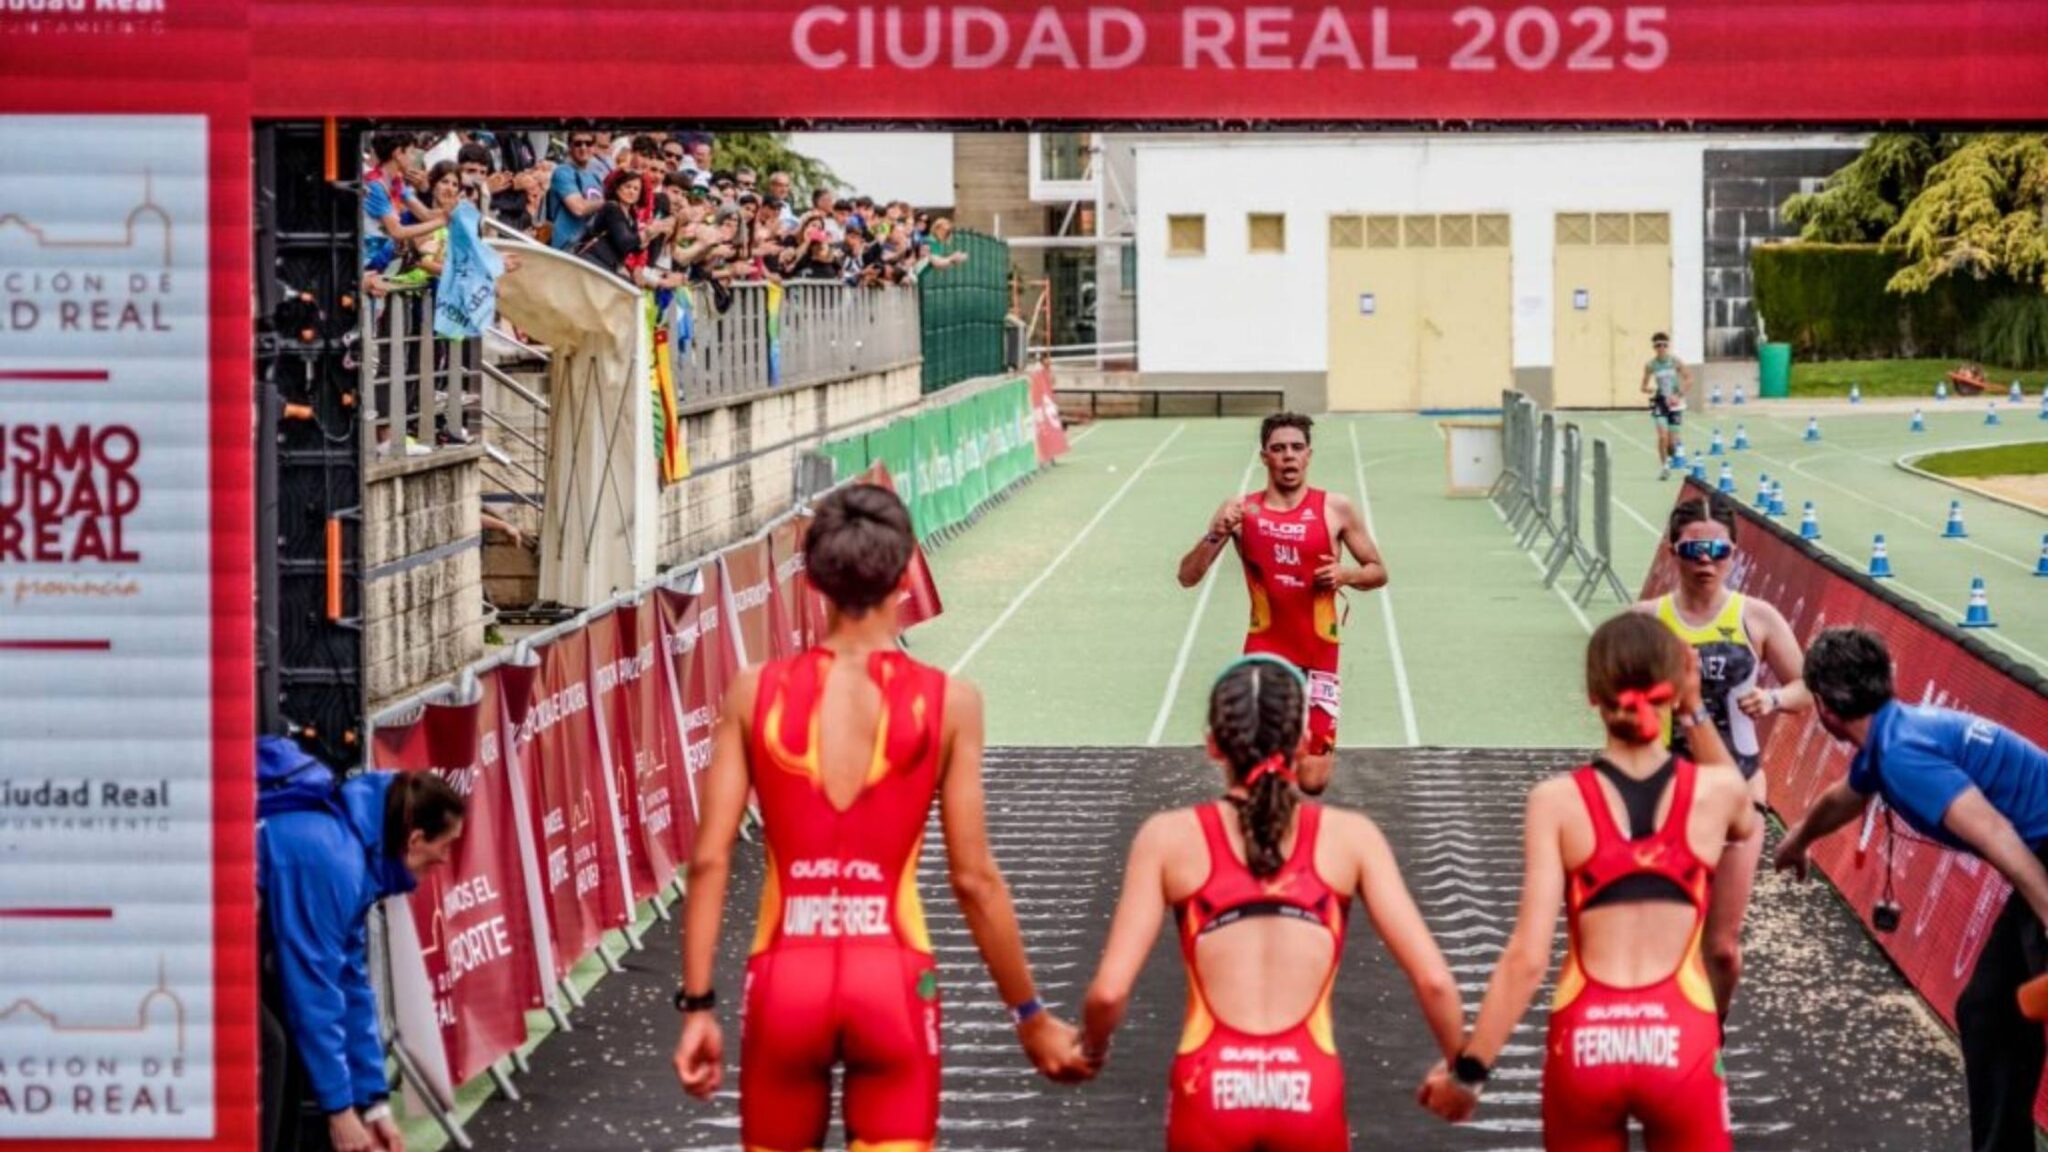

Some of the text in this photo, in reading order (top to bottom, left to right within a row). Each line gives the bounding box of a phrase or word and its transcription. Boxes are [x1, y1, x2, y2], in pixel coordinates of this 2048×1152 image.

[791, 6, 1670, 71] CIUDAD REAL 2025
[129, 273, 172, 293] DE
[60, 300, 172, 331] REAL
[0, 515, 140, 563] REAL
[1273, 543, 1301, 566] SALA
[102, 779, 169, 808] Real
[141, 1057, 185, 1077] DE
[73, 1084, 184, 1114] REAL
